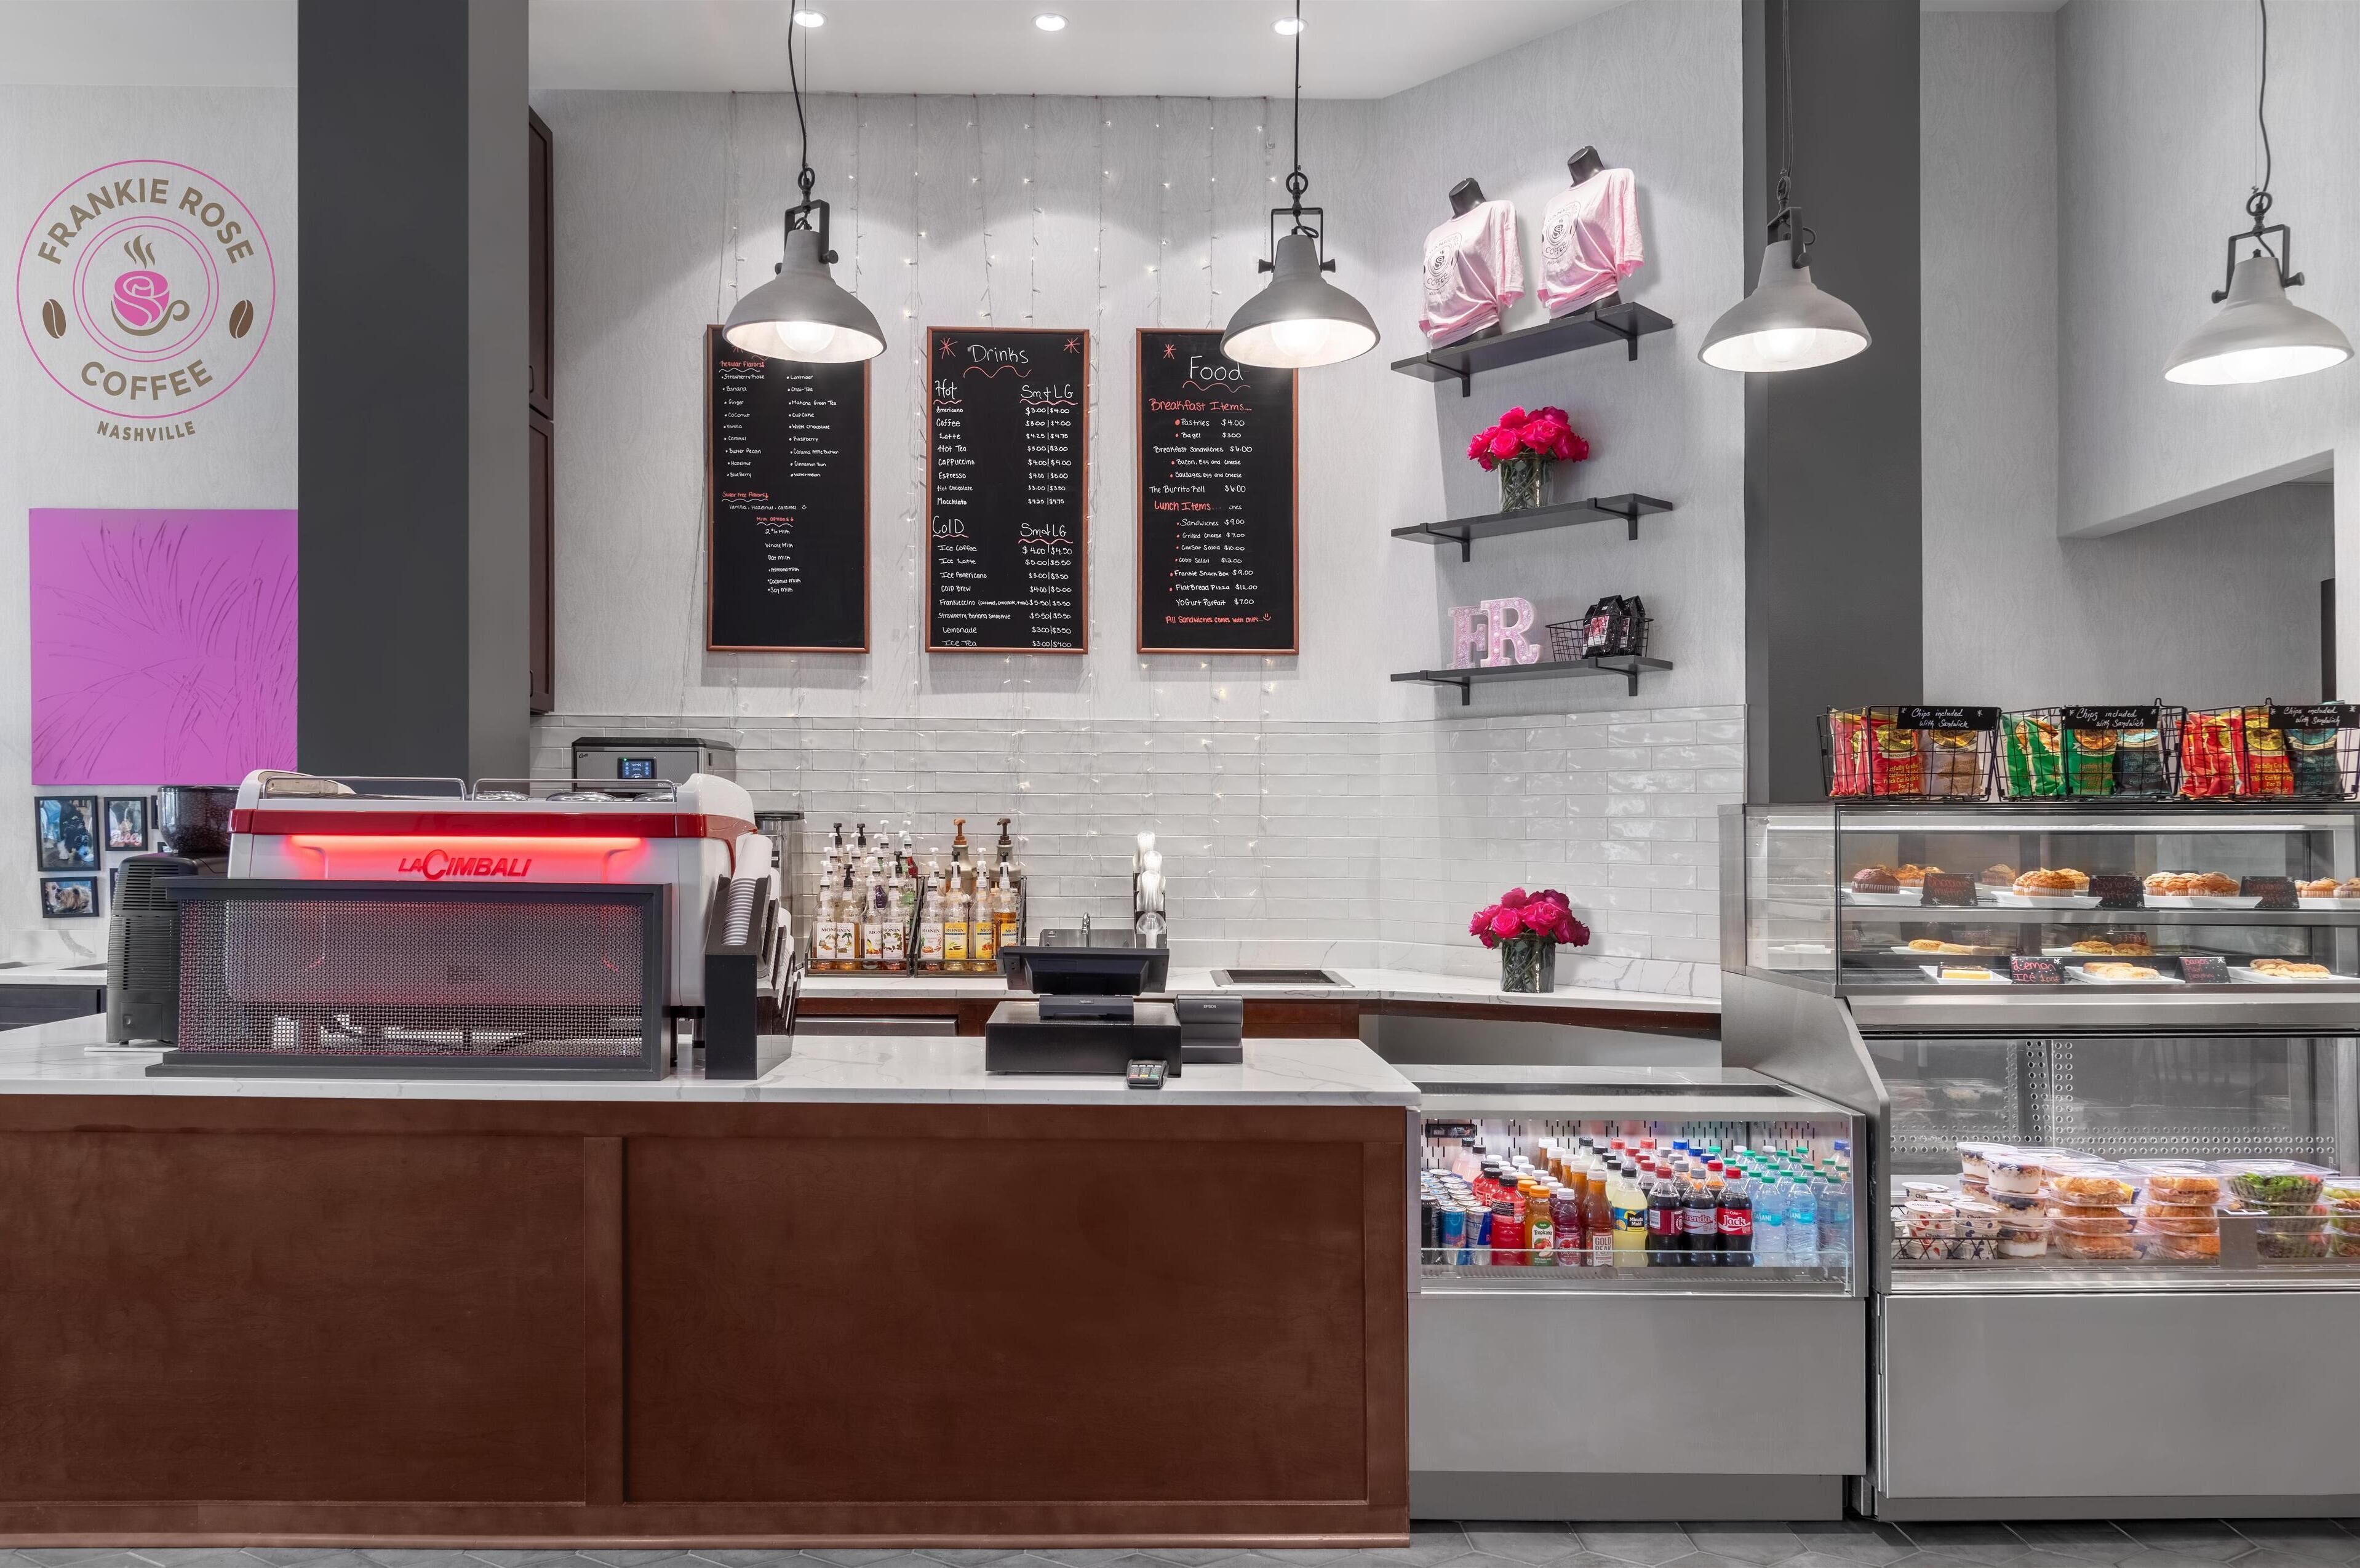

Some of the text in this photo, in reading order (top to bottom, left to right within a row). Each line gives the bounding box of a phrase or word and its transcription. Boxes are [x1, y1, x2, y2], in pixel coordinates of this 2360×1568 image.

[38, 178, 254, 265] FRANKIE ROSE
[968, 345, 1028, 363] Drinks
[1189, 355, 1244, 381] Food
[81, 359, 213, 400] COFFEE
[935, 379, 957, 399] Hot
[1021, 384, 1042, 399] Sm
[1149, 399, 1205, 411] Breakfast
[936, 418, 960, 427] Coffee
[97, 421, 196, 442] NASHVILLE
[1154, 501, 1179, 511] Lunch
[1912, 708, 1963, 718] Chips included
[2076, 708, 2098, 722] Chips
[2284, 707, 2302, 717] Chips
[2112, 718, 2143, 728] Sandwich
[2312, 716, 2340, 726] Sandwich
[2012, 959, 2056, 971] Lemon
[2013, 973, 2036, 982] Ice
[1723, 1216, 1747, 1227] Jack
[1595, 1237, 1611, 1246] GOLD
